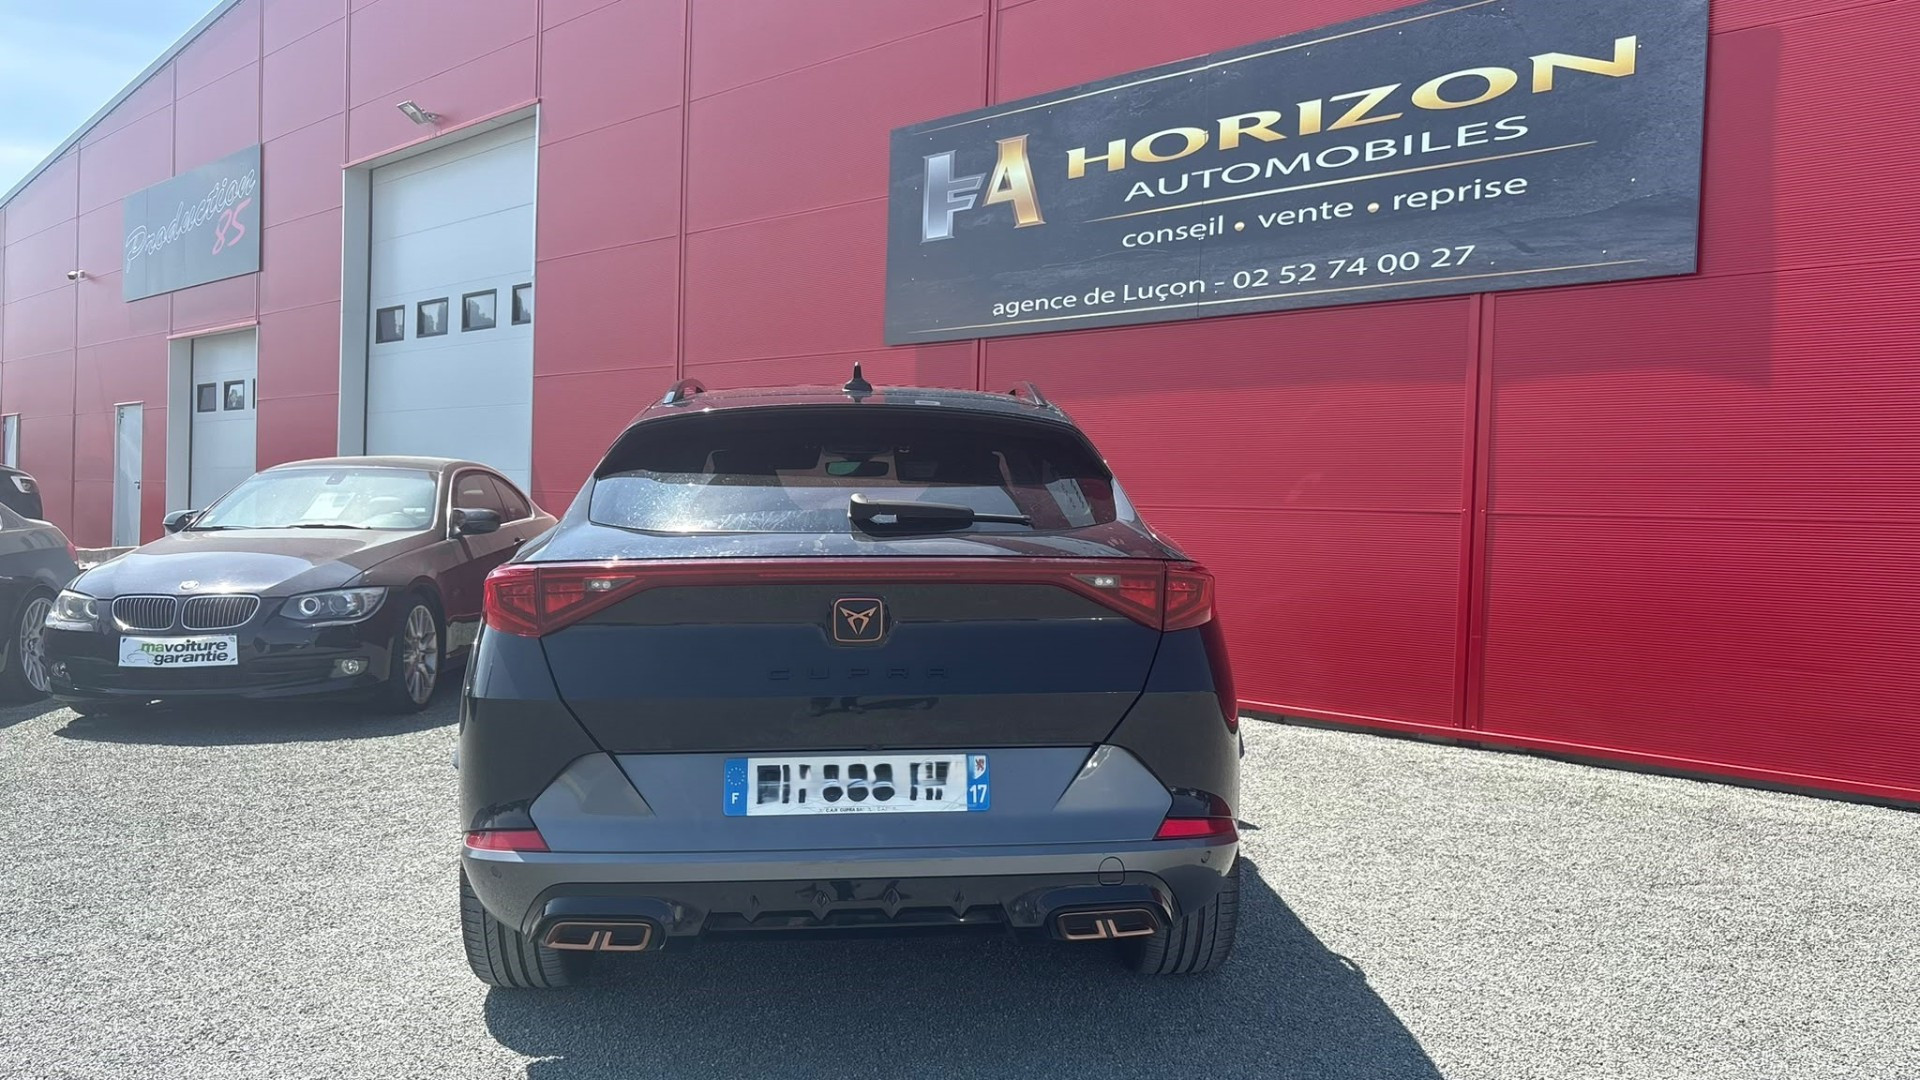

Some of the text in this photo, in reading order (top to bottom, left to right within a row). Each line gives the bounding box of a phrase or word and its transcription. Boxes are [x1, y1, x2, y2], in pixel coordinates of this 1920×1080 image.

[1066, 35, 1637, 180] HORIZON
[1124, 115, 1529, 202] AUTOMOBILES
[125, 168, 256, 273] Production
[212, 198, 252, 255] 85
[1122, 178, 1528, 248] conseil vente reprise
[992, 294, 1077, 318] agence
[1083, 287, 1115, 305] de
[1124, 278, 1206, 302] Luçon
[1232, 269, 1269, 289] 02
[1278, 263, 1317, 284] 52
[1327, 258, 1368, 278] 74
[1377, 251, 1420, 273] 00
[1431, 245, 1476, 268] 27
[141, 639, 228, 653] mavoiture
[153, 650, 228, 666] garantie
[768, 667, 948, 680] CUPRA
[731, 792, 739, 804] F
[969, 784, 987, 803] 17
